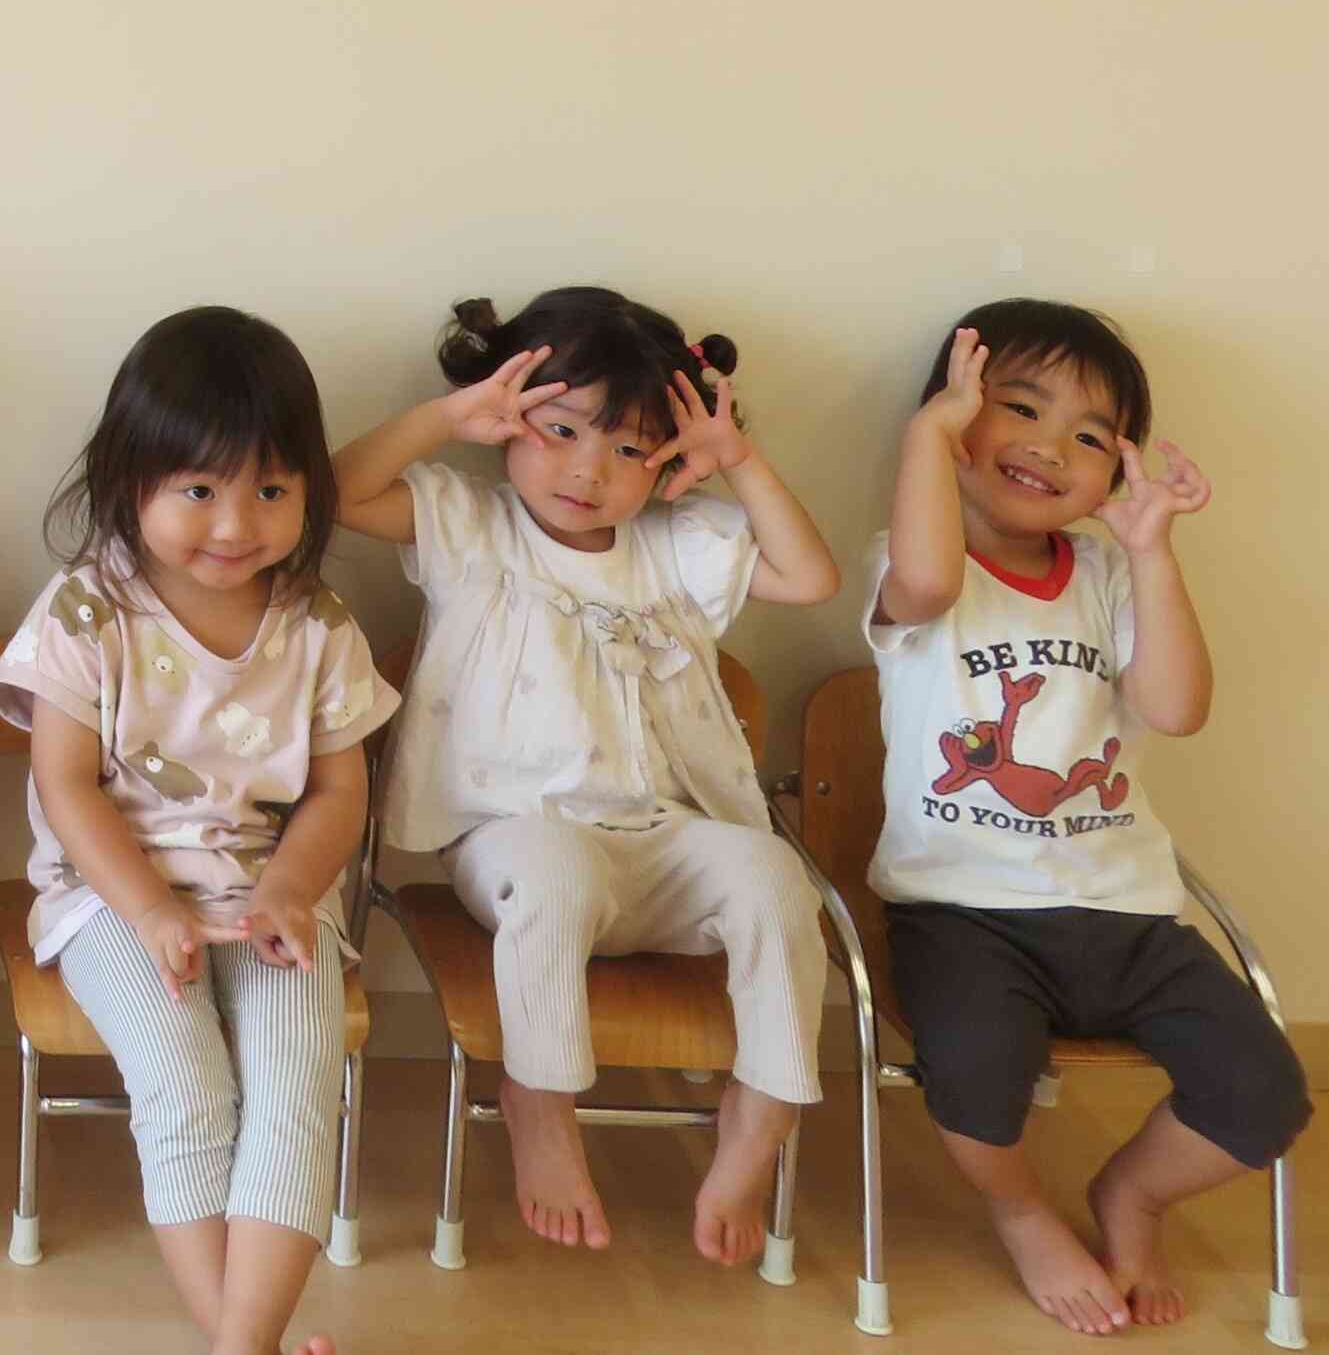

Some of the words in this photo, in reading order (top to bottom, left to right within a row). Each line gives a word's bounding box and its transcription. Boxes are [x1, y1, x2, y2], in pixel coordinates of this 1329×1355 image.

[961, 642, 1017, 678] BE
[922, 796, 960, 824] TO
[969, 806, 1058, 839] YOUR
